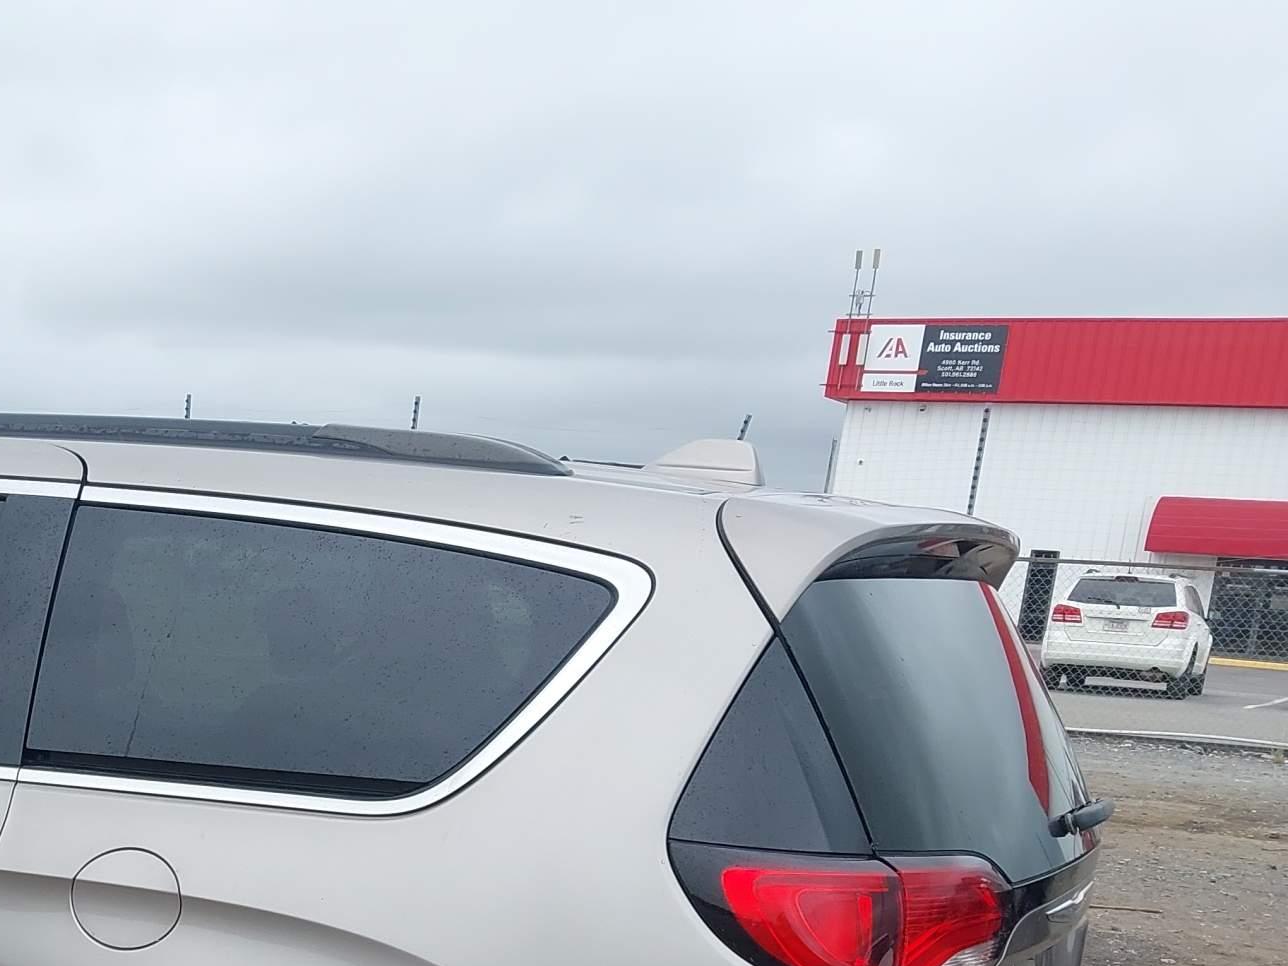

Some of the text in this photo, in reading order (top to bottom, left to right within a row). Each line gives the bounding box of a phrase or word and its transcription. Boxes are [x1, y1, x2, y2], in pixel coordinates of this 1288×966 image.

[939, 330, 992, 340] Insurance
[926, 342, 1001, 353] Auto Auctions
